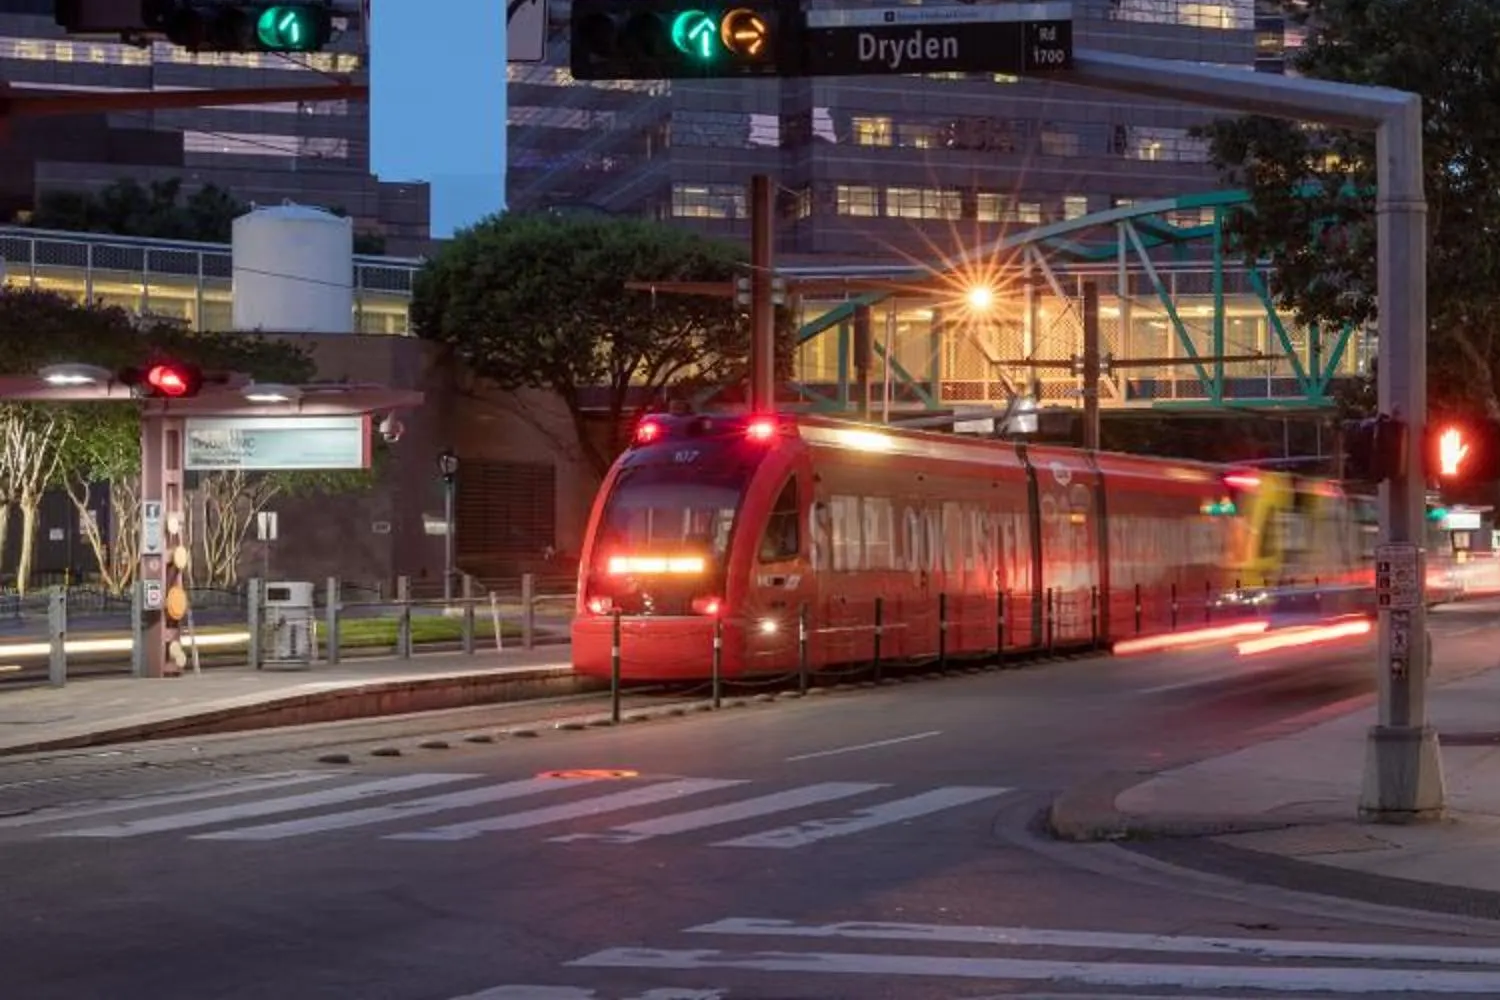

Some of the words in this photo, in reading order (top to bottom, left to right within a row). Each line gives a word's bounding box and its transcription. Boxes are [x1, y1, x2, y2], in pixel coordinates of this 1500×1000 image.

[1039, 26, 1057, 42] Rd
[858, 30, 959, 68] Dryden
[1032, 49, 1066, 65] 1700
